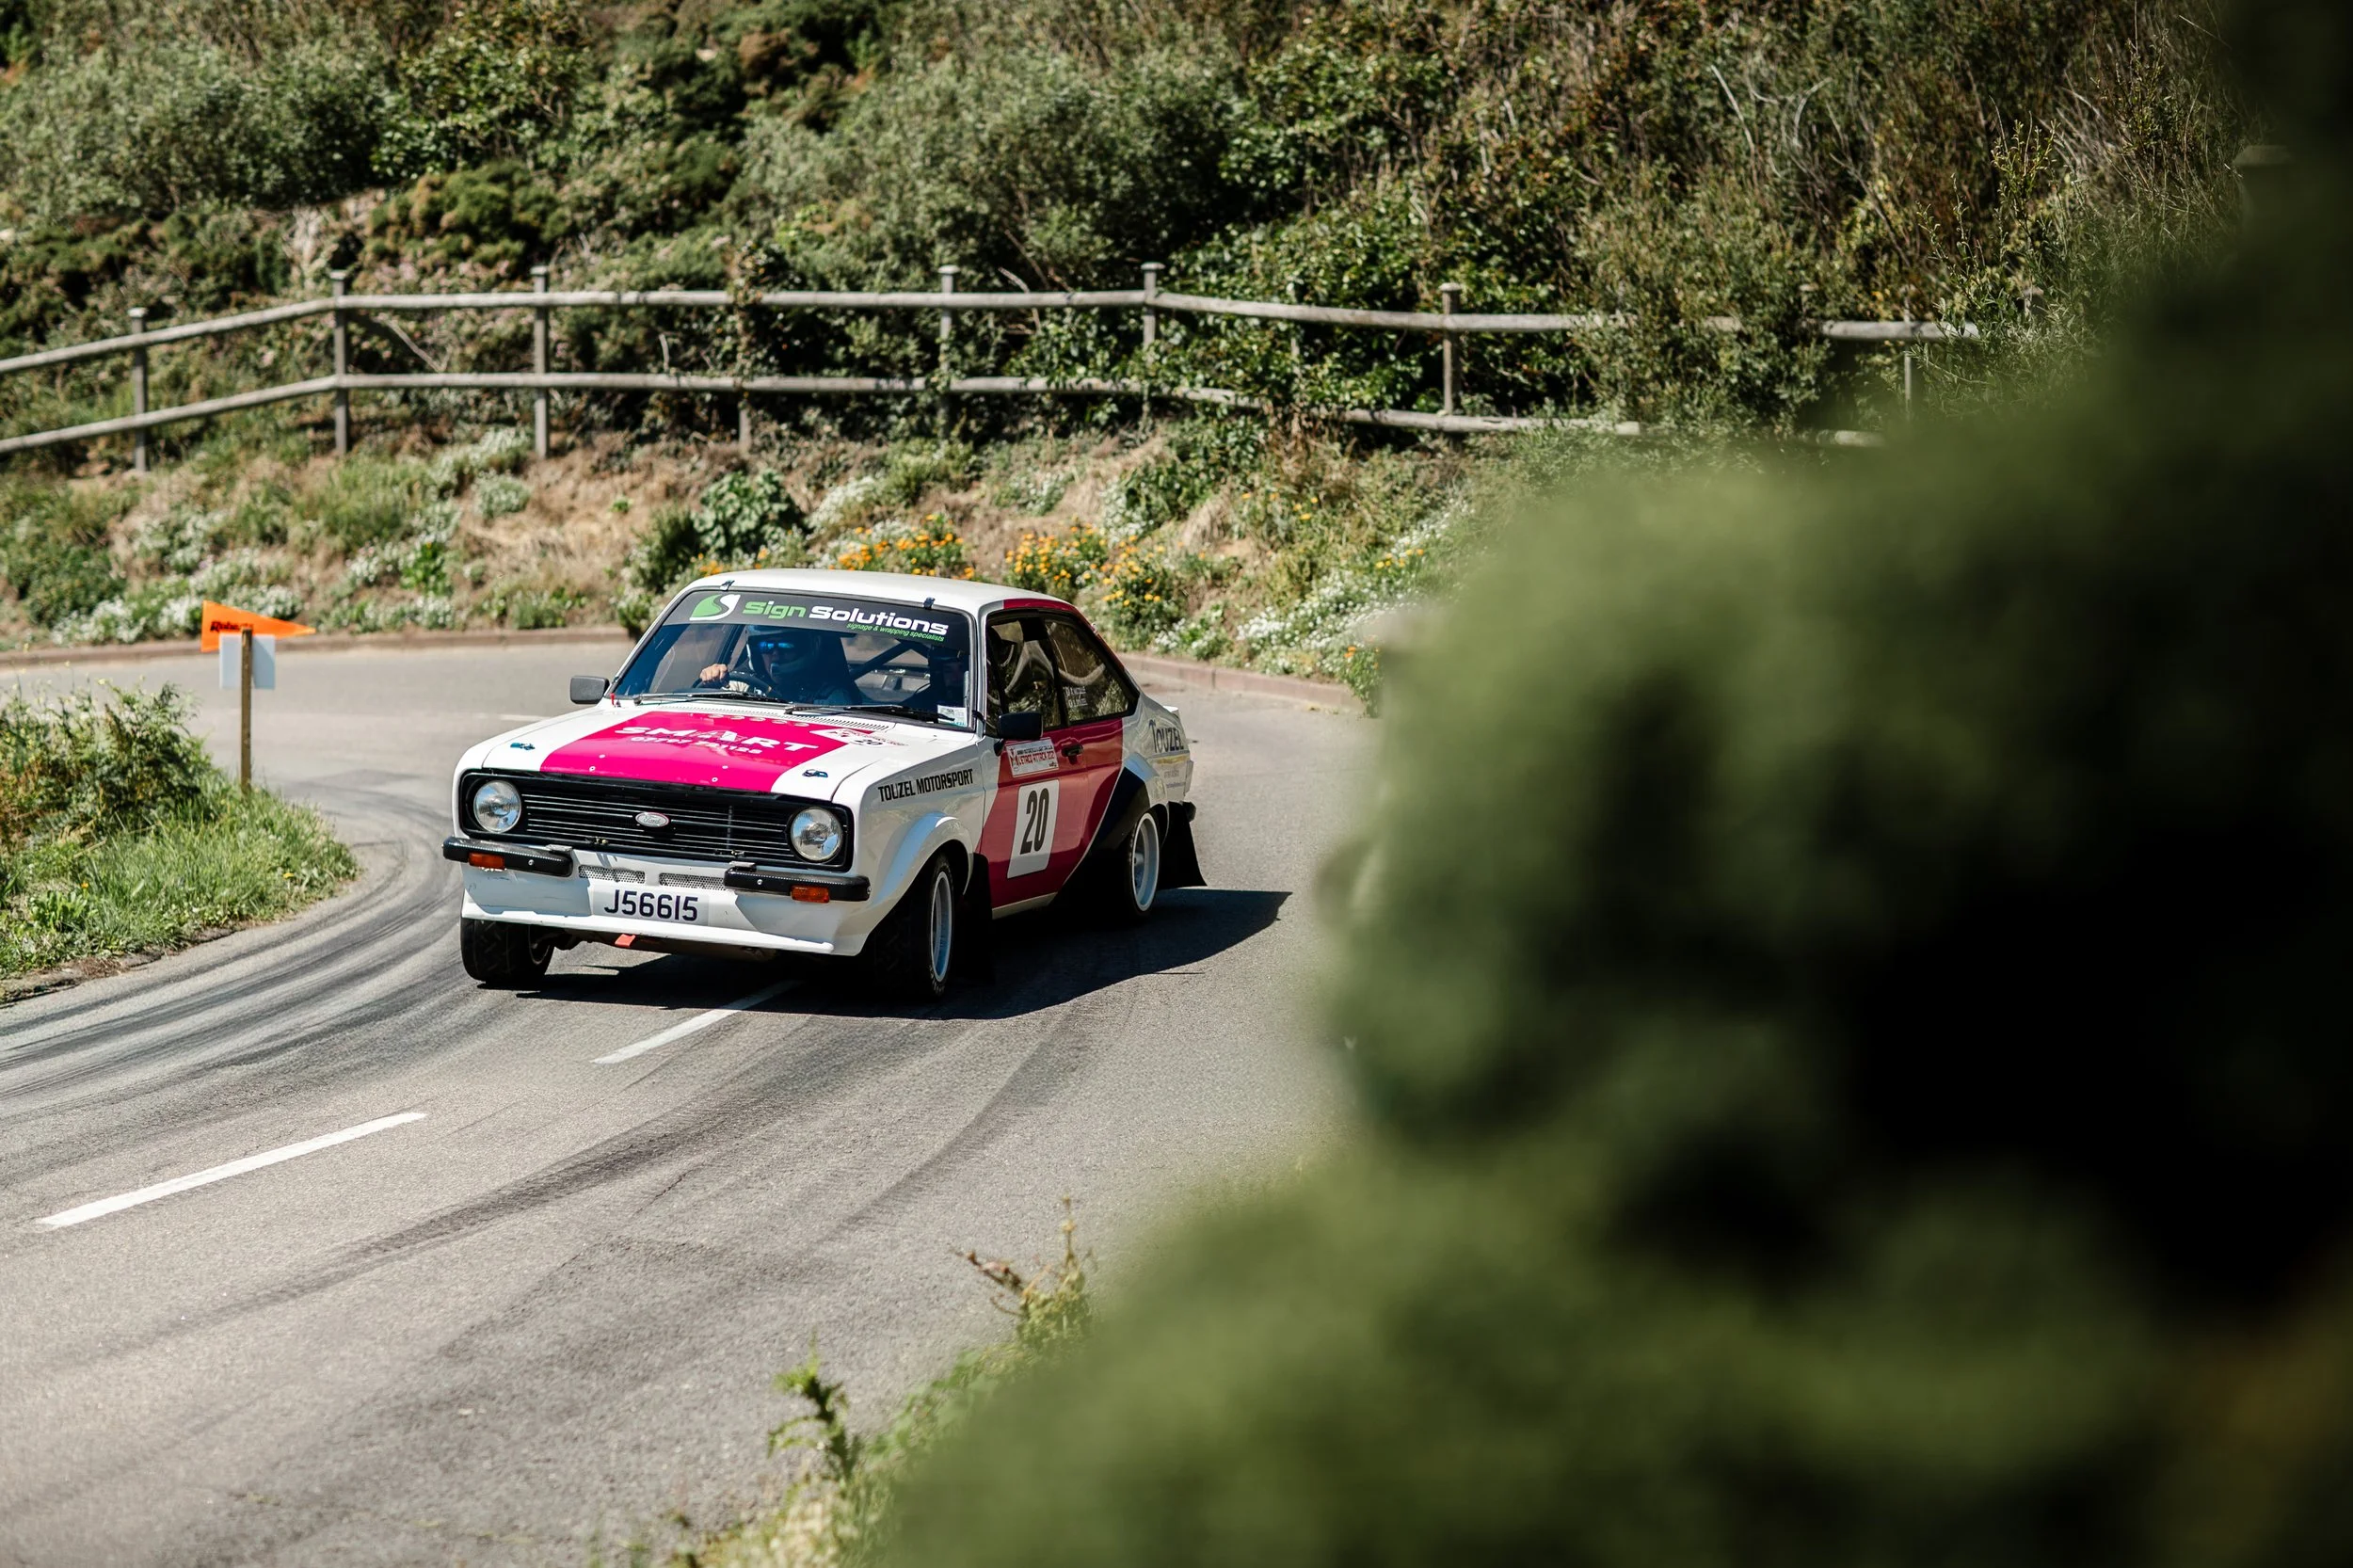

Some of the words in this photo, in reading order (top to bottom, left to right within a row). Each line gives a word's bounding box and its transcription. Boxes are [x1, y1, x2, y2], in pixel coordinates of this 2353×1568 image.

[743, 600, 806, 619] Sign
[808, 605, 949, 636] Solutions
[846, 622, 872, 632] signage
[879, 627, 910, 637] wrapping
[909, 631, 945, 642] specialists
[615, 727, 819, 751] SMART
[878, 781, 916, 802] TOUZEL
[917, 769, 973, 794] MOTORSPORT
[643, 815, 663, 824] Ford
[1020, 788, 1049, 855] 20
[603, 889, 698, 921] J56615
